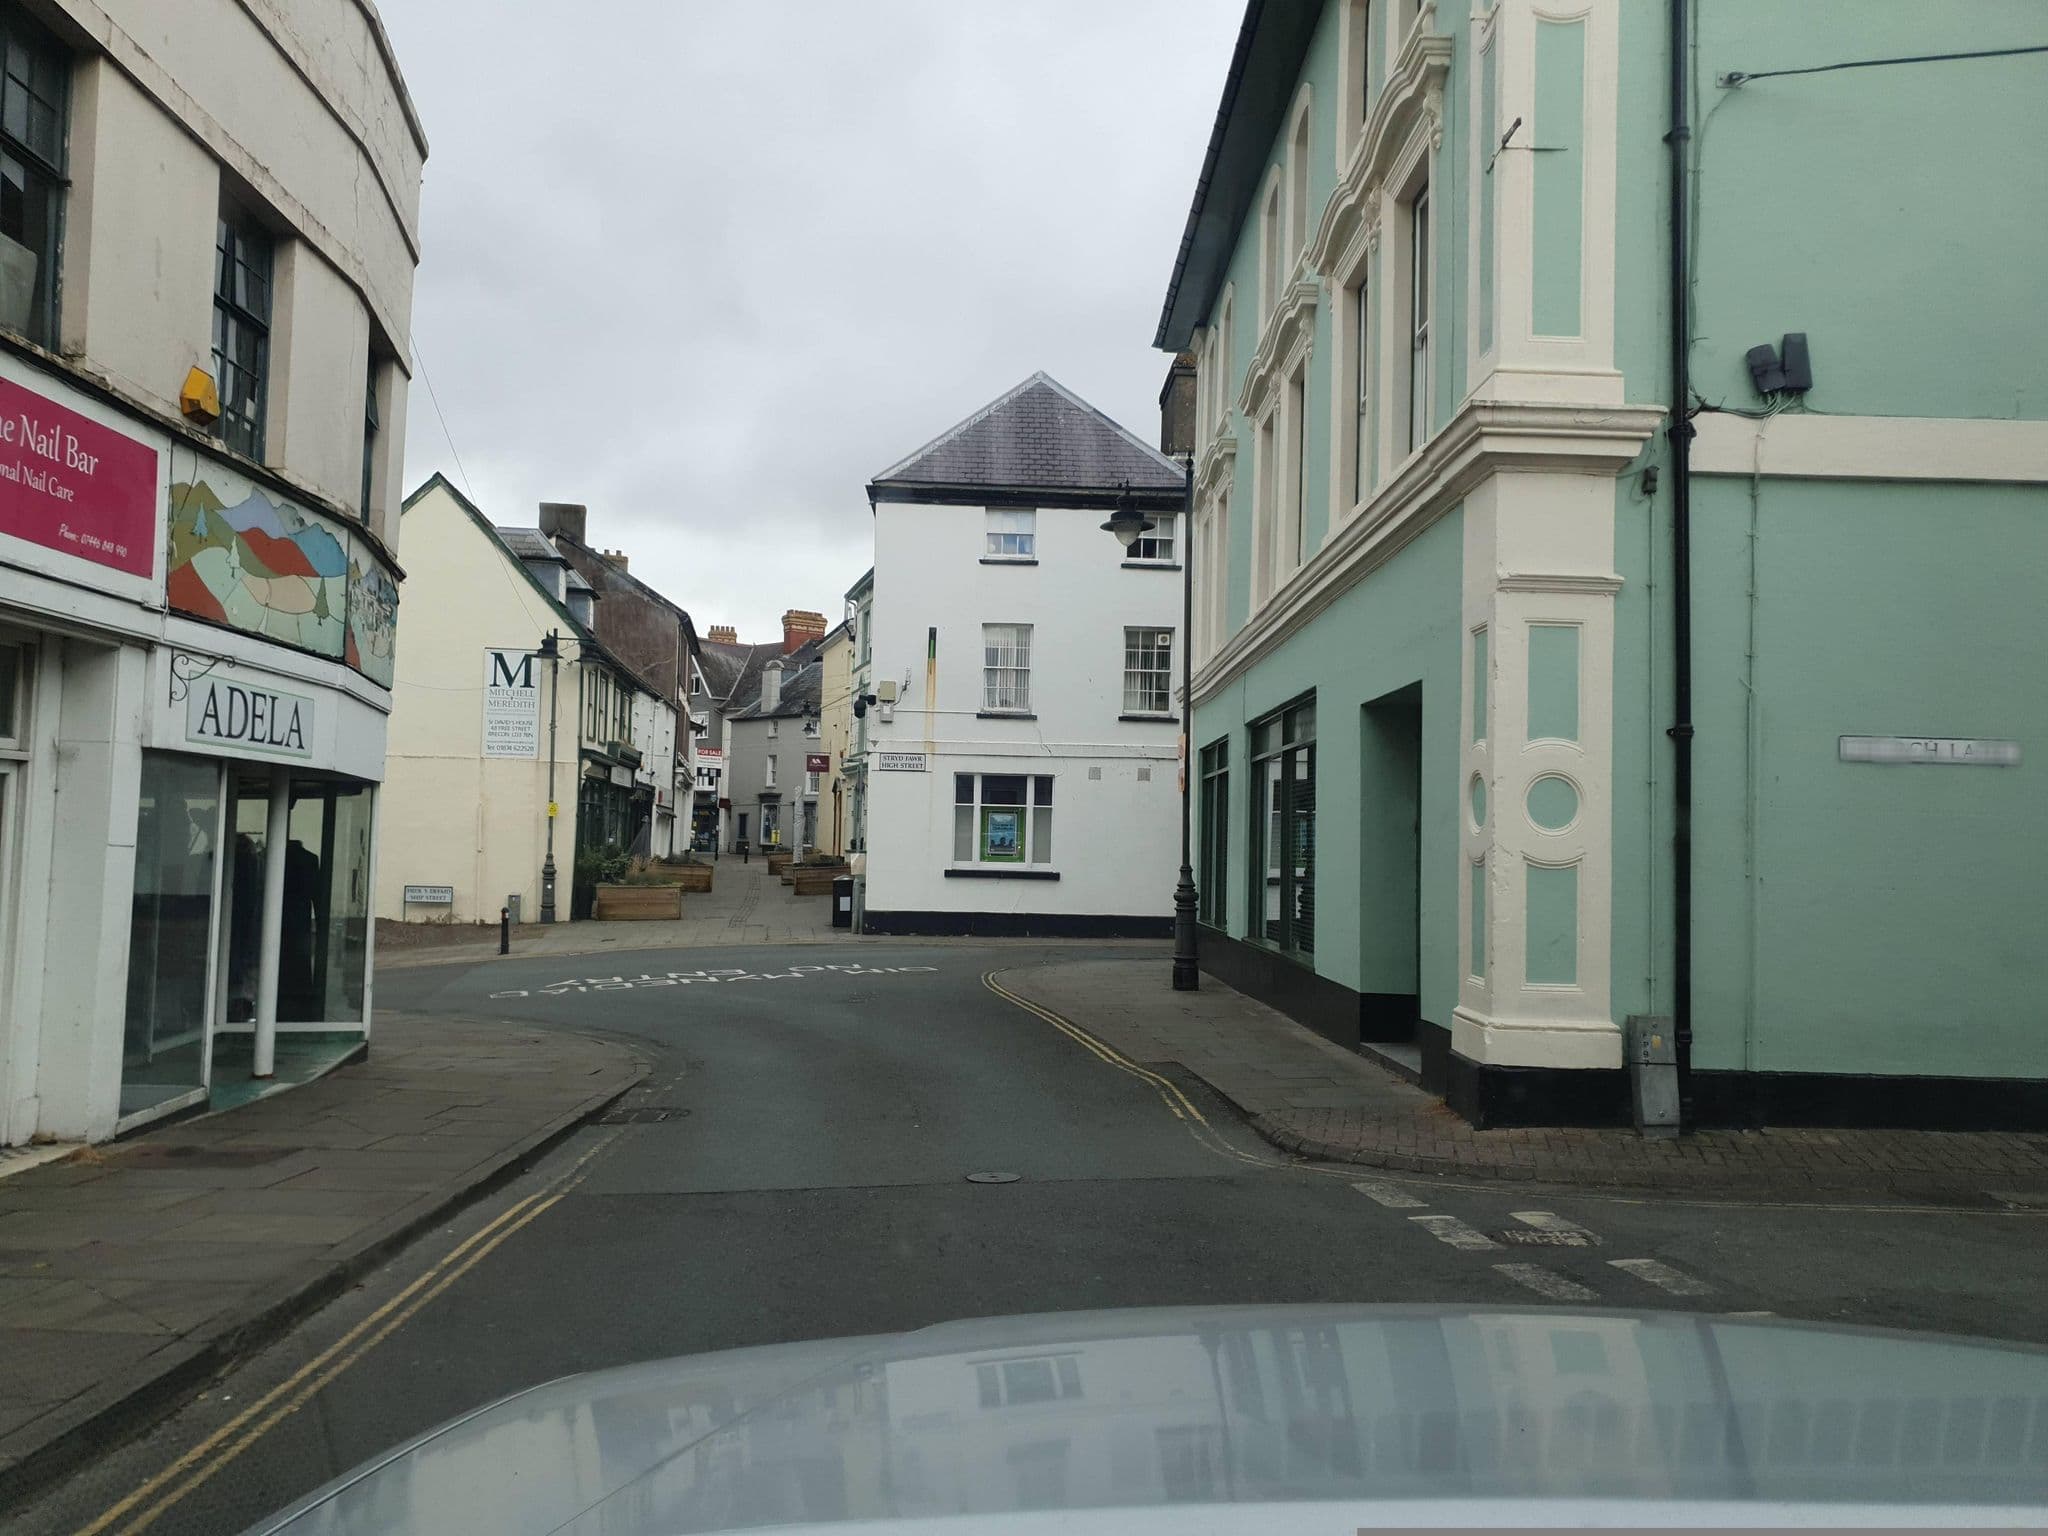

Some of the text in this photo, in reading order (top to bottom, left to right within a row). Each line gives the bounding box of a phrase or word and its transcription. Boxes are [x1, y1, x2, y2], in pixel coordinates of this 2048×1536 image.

[20, 414, 61, 462] Nail
[65, 434, 99, 476] Bar
[22, 466, 46, 493] Nail
[49, 476, 75, 502] Care
[489, 652, 535, 688] M
[488, 688, 535, 698] MITCHELL
[488, 699, 536, 709] MEREDITH
[197, 680, 305, 750] ADELA
